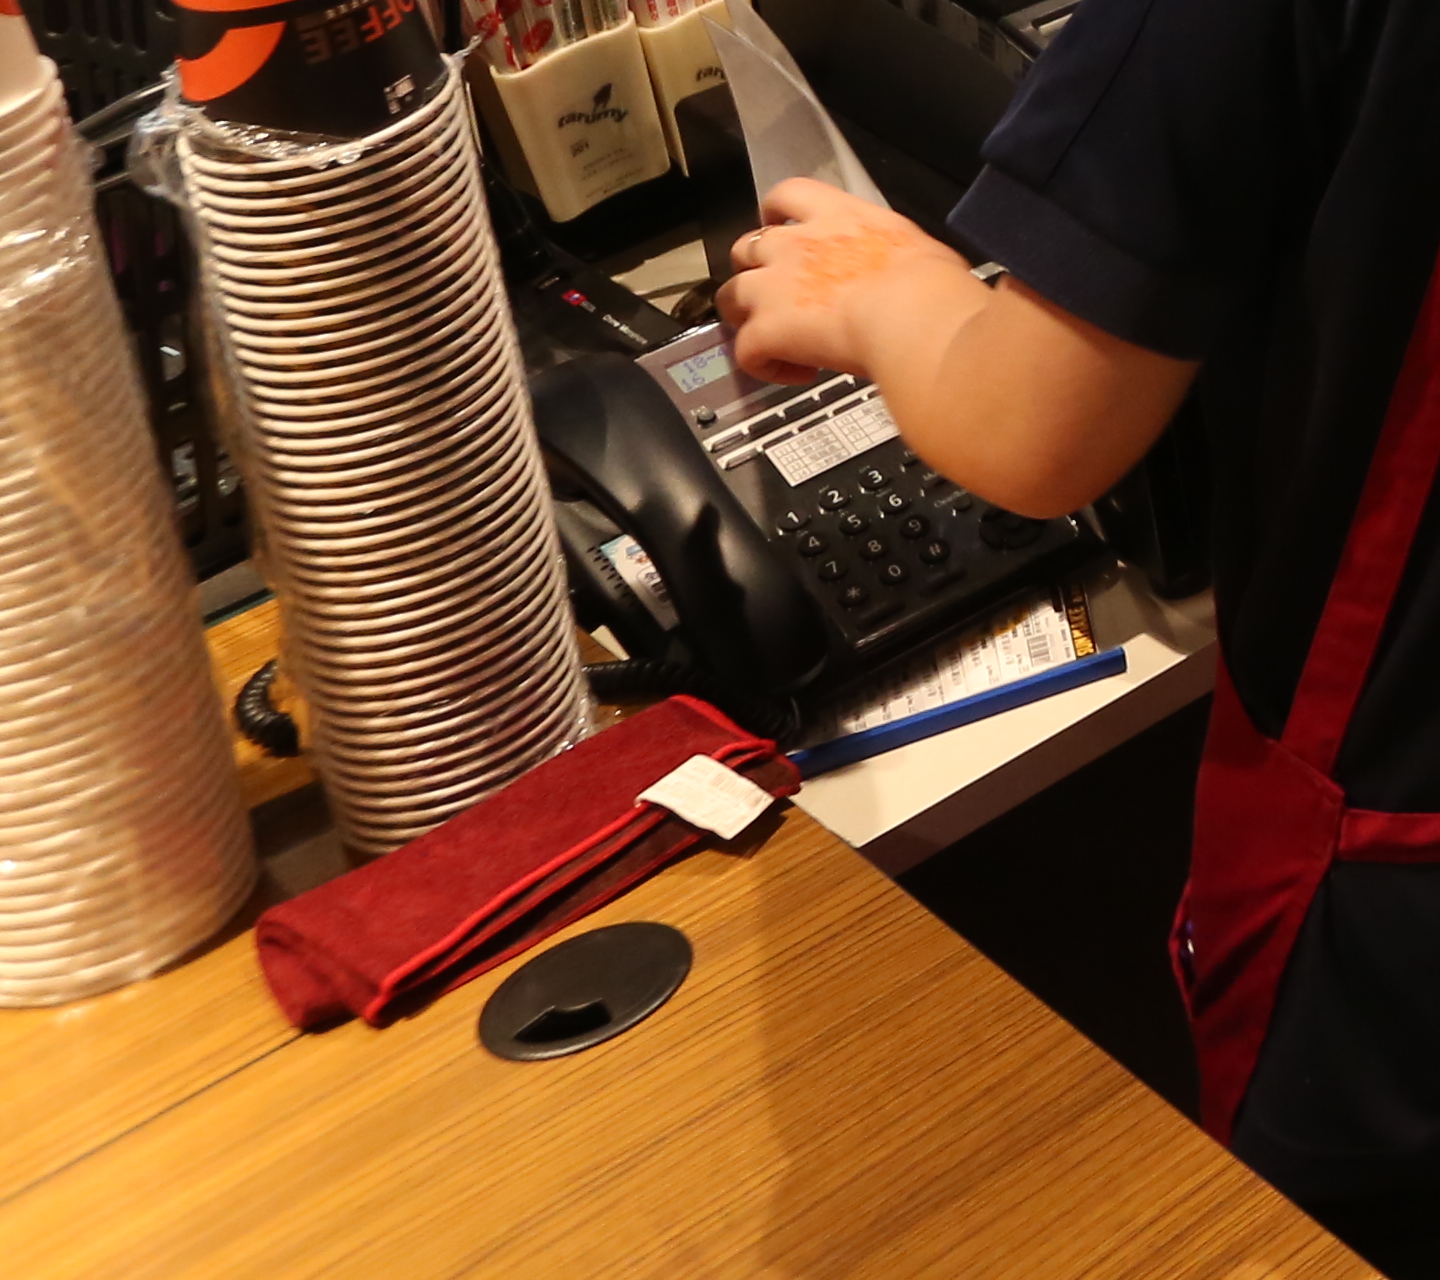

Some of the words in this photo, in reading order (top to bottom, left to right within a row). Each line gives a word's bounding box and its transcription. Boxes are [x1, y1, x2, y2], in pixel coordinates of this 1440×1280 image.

[868, 469, 884, 484] 3
[827, 489, 844, 504] 2
[888, 492, 903, 508] 6
[787, 511, 800, 525] 1
[847, 514, 862, 529] 5
[908, 518, 922, 535] 9
[808, 535, 821, 549] 4
[867, 539, 882, 555] 8
[825, 559, 838, 574] 7
[888, 564, 902, 579] 0
